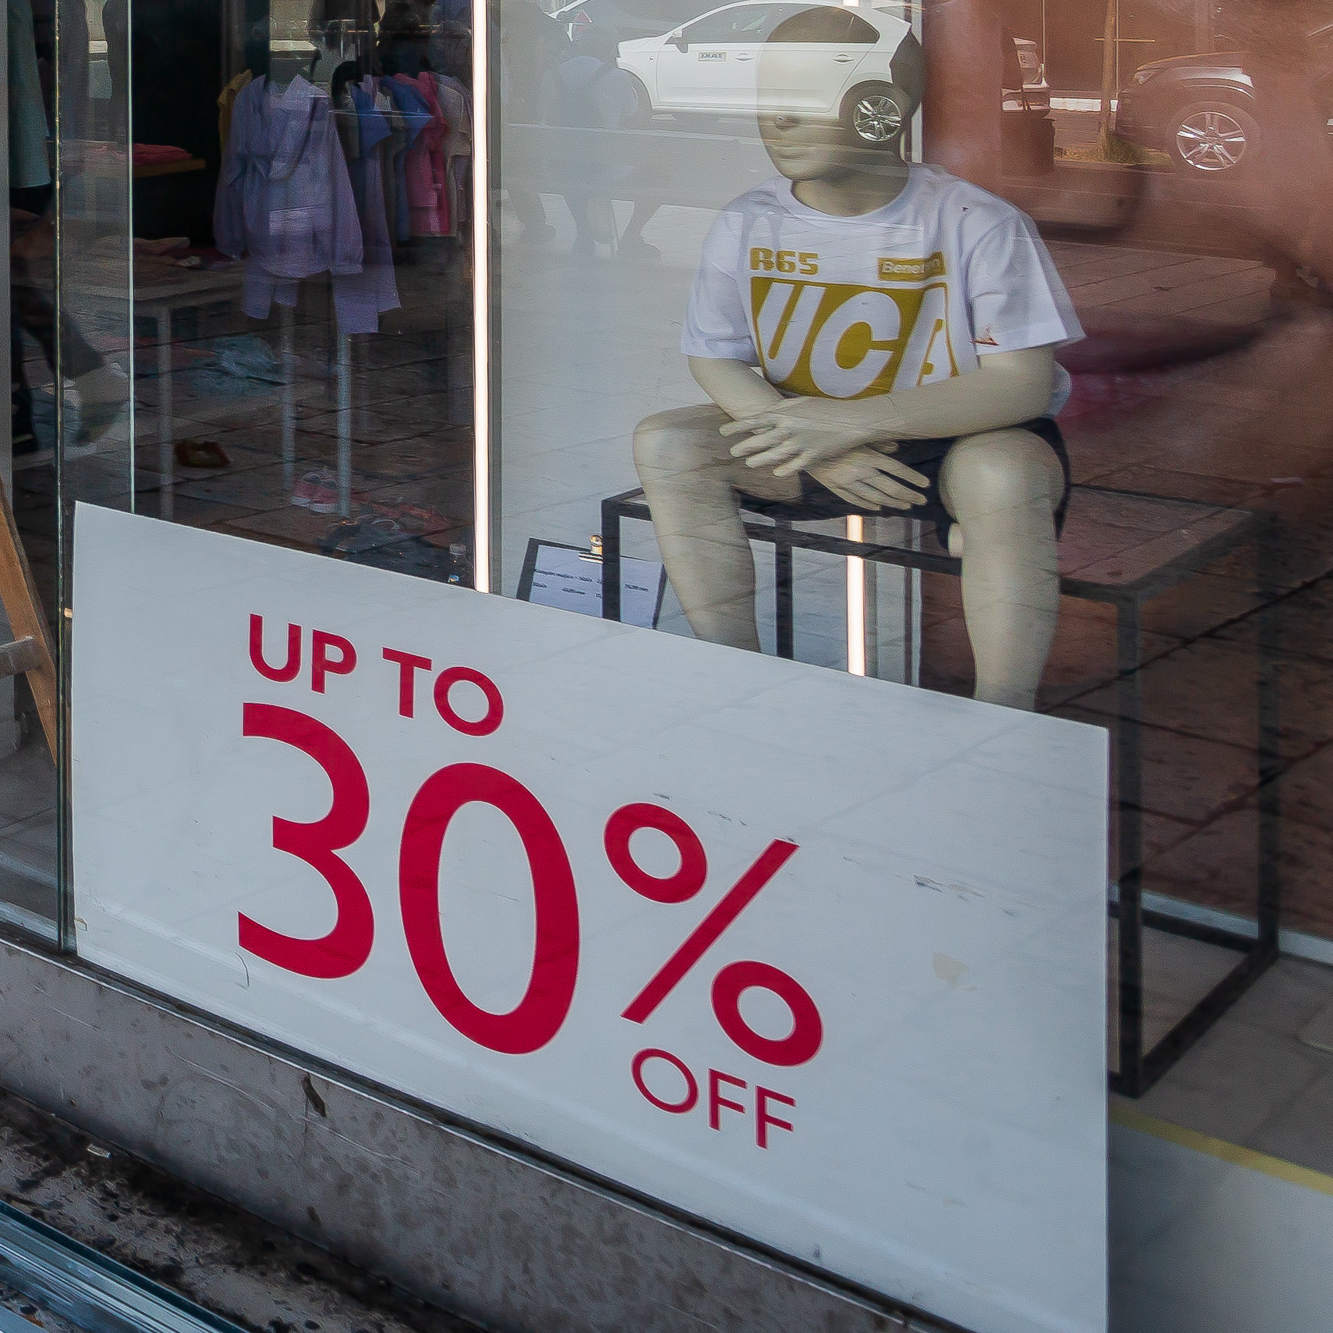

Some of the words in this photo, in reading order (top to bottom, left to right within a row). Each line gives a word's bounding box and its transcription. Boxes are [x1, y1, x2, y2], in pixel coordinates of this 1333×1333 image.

[249, 614, 357, 693] UP
[383, 647, 503, 737] TO
[238, 703, 823, 1067] 30%
[631, 1048, 796, 1149] OFF
